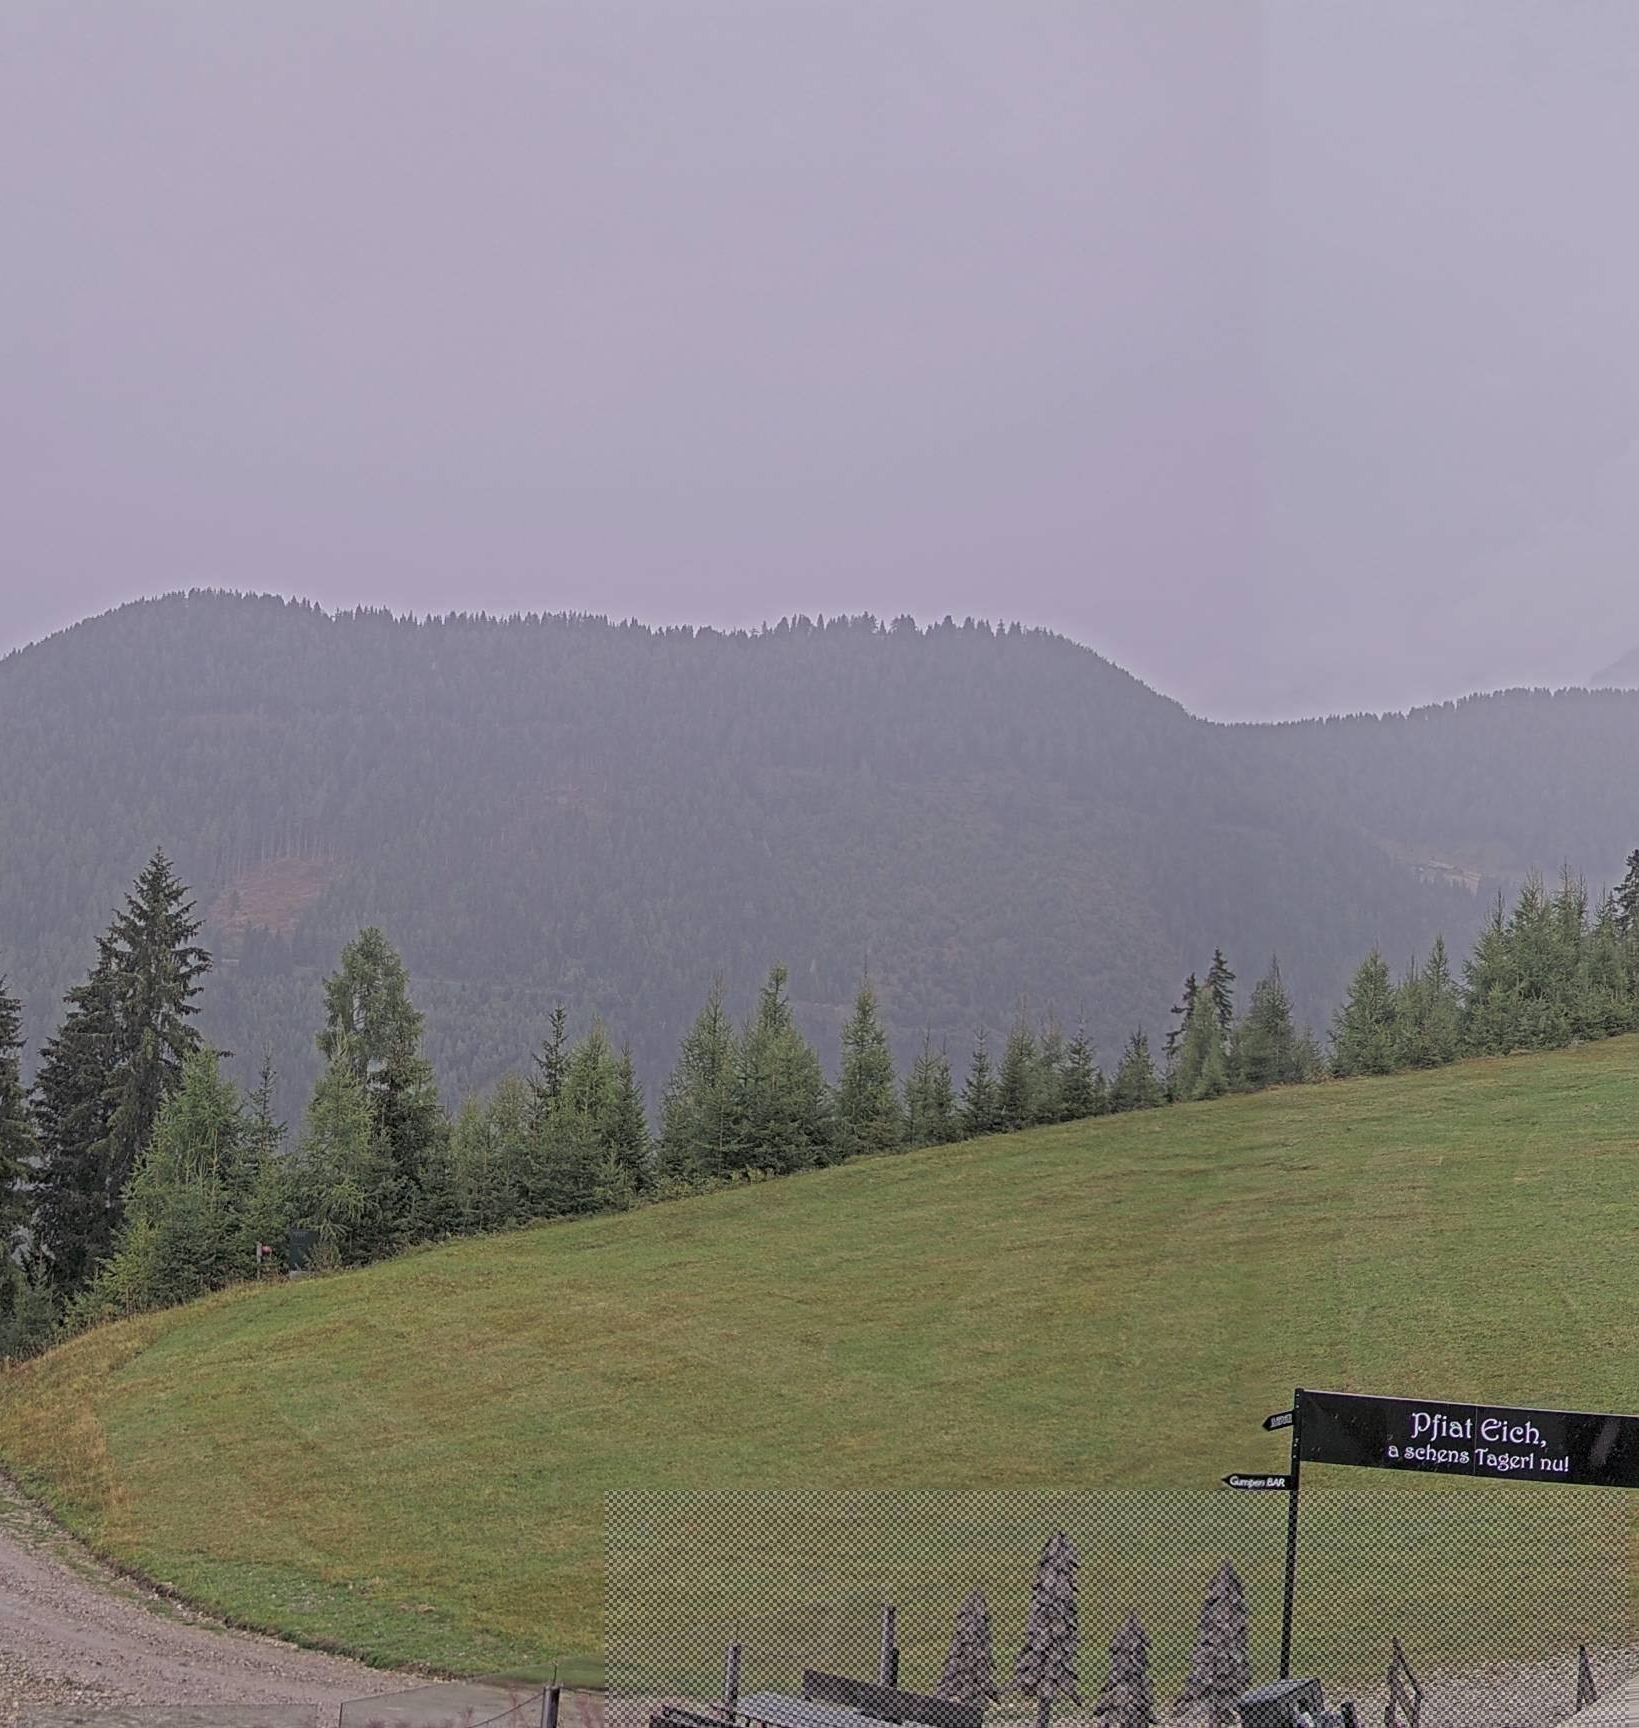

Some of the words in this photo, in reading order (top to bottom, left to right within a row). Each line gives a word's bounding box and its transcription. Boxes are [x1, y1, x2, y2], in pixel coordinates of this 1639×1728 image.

[1410, 1412, 1473, 1441] Pfiat
[1481, 1418, 1547, 1448] Eich,
[1388, 1445, 1399, 1458] a
[1404, 1444, 1470, 1464] schens
[1475, 1448, 1534, 1471] Tagerl
[1540, 1456, 1570, 1472] nu!
[1266, 1477, 1285, 1487] BAR
